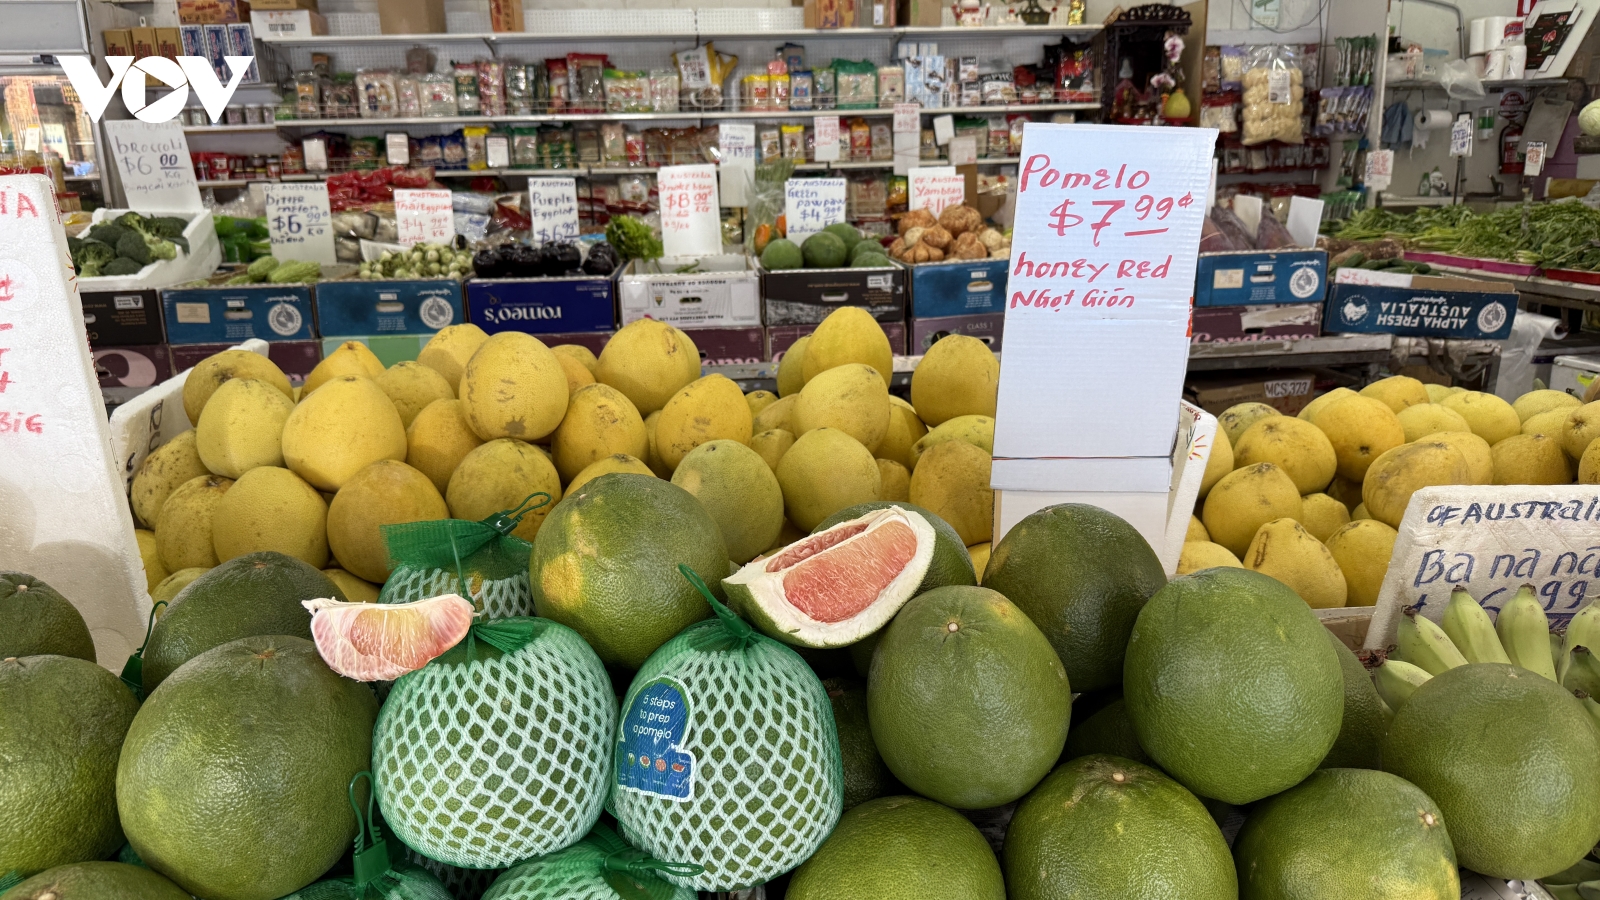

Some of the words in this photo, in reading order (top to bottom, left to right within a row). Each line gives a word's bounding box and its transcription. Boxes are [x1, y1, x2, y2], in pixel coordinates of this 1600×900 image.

[1019, 153, 1150, 192] Pomelo
[1013, 251, 1110, 283] honey
[483, 305, 562, 325] romeo's
[1380, 301, 1471, 318] AUSTRALIA
[966, 322, 989, 331] CLASS
[1376, 313, 1419, 328] FRESH
[1423, 317, 1469, 329] ALPHA
[649, 696, 676, 711] steps
[648, 711, 671, 725] prep
[638, 725, 672, 740] pomelo
